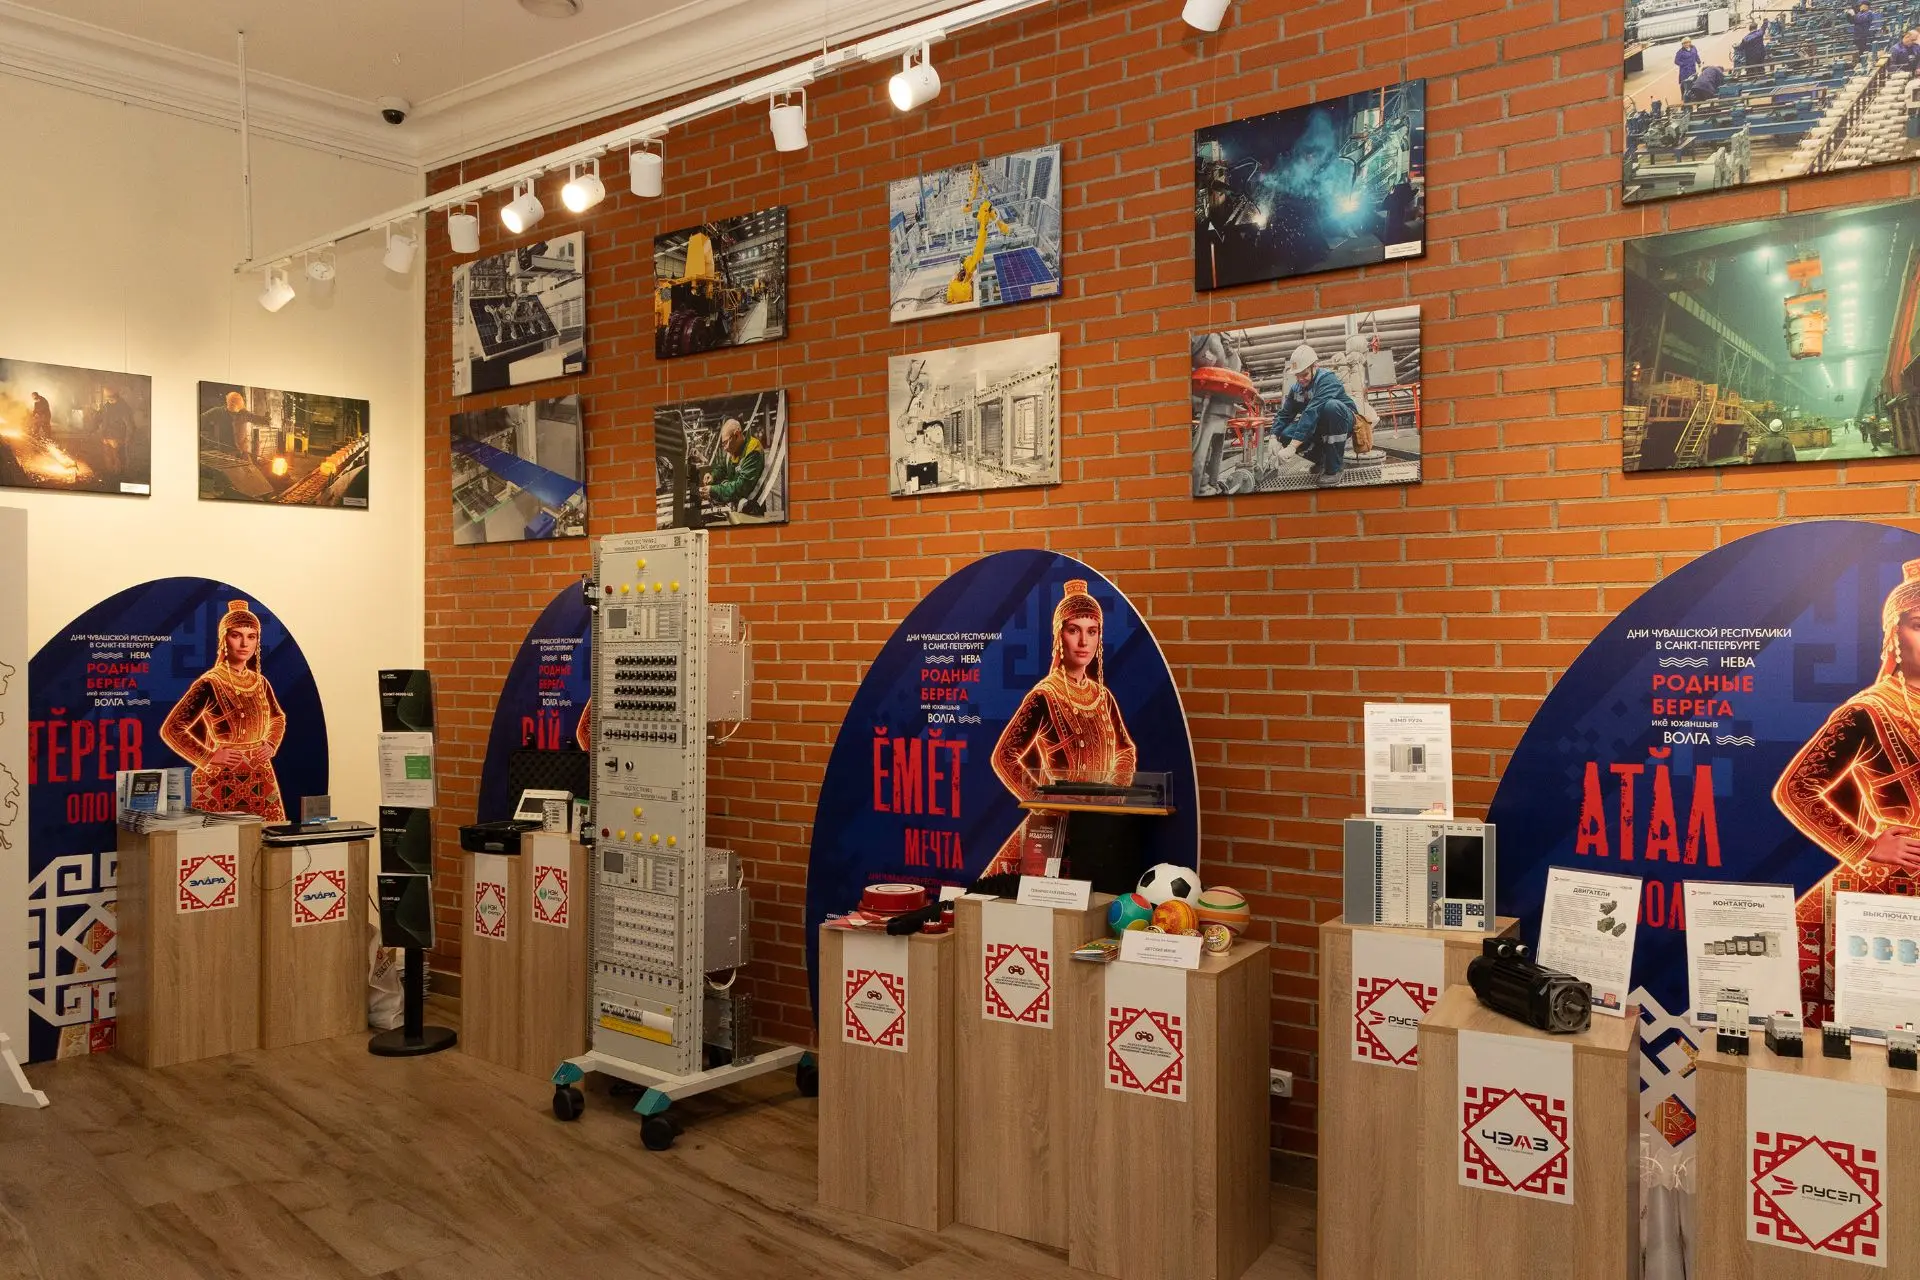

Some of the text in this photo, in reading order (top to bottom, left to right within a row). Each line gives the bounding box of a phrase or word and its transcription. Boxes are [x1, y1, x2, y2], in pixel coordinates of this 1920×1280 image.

[906, 633, 920, 641] ДНИ
[921, 632, 960, 641] ЧУВАШСКОЙ
[1627, 627, 1791, 639] ДНИ ЧУВАШСКОЙ РЕСПУБЛИКИ
[928, 642, 984, 650] САНКТ-ПЕТЕРБУРГЕ
[1656, 641, 1760, 650] В САНКТ-ПЕТЕРБУРГЕ
[961, 655, 981, 663] НЕВА
[1720, 657, 1756, 667] НЕВА
[87, 663, 150, 674] РОДНЫЕ
[539, 665, 572, 676] РОДНЫЕ
[921, 668, 980, 684] РОДНЫЕ
[86, 678, 138, 688] БЕРЕГА
[539, 679, 565, 689] БЕРЕГА
[1652, 674, 1754, 694] РОДНЫЕ
[921, 688, 968, 701] БЕРЕГА
[94, 698, 124, 706] ВОЛГА
[542, 699, 558, 707] ВОЛГА
[1652, 698, 1733, 716] БЕРЕГА
[928, 714, 956, 723] ВОЛГА
[1664, 732, 1710, 744] ВОЛГА
[873, 726, 967, 818] ӖМӖТ
[67, 792, 116, 824] ОПО
[1575, 746, 1722, 867] АТӐЛ
[905, 828, 964, 869] МЕЧТА
[190, 876, 226, 886] ЭЛАРА
[304, 891, 336, 901] ЭЛАРА
[1573, 887, 1611, 898] ДВИГАТЕЛИ
[1638, 880, 1686, 930] ОЛ
[1863, 911, 1920, 921] ВЫКЛЮЧАТЕ
[1482, 1129, 1548, 1151] ЧЭАЗ
